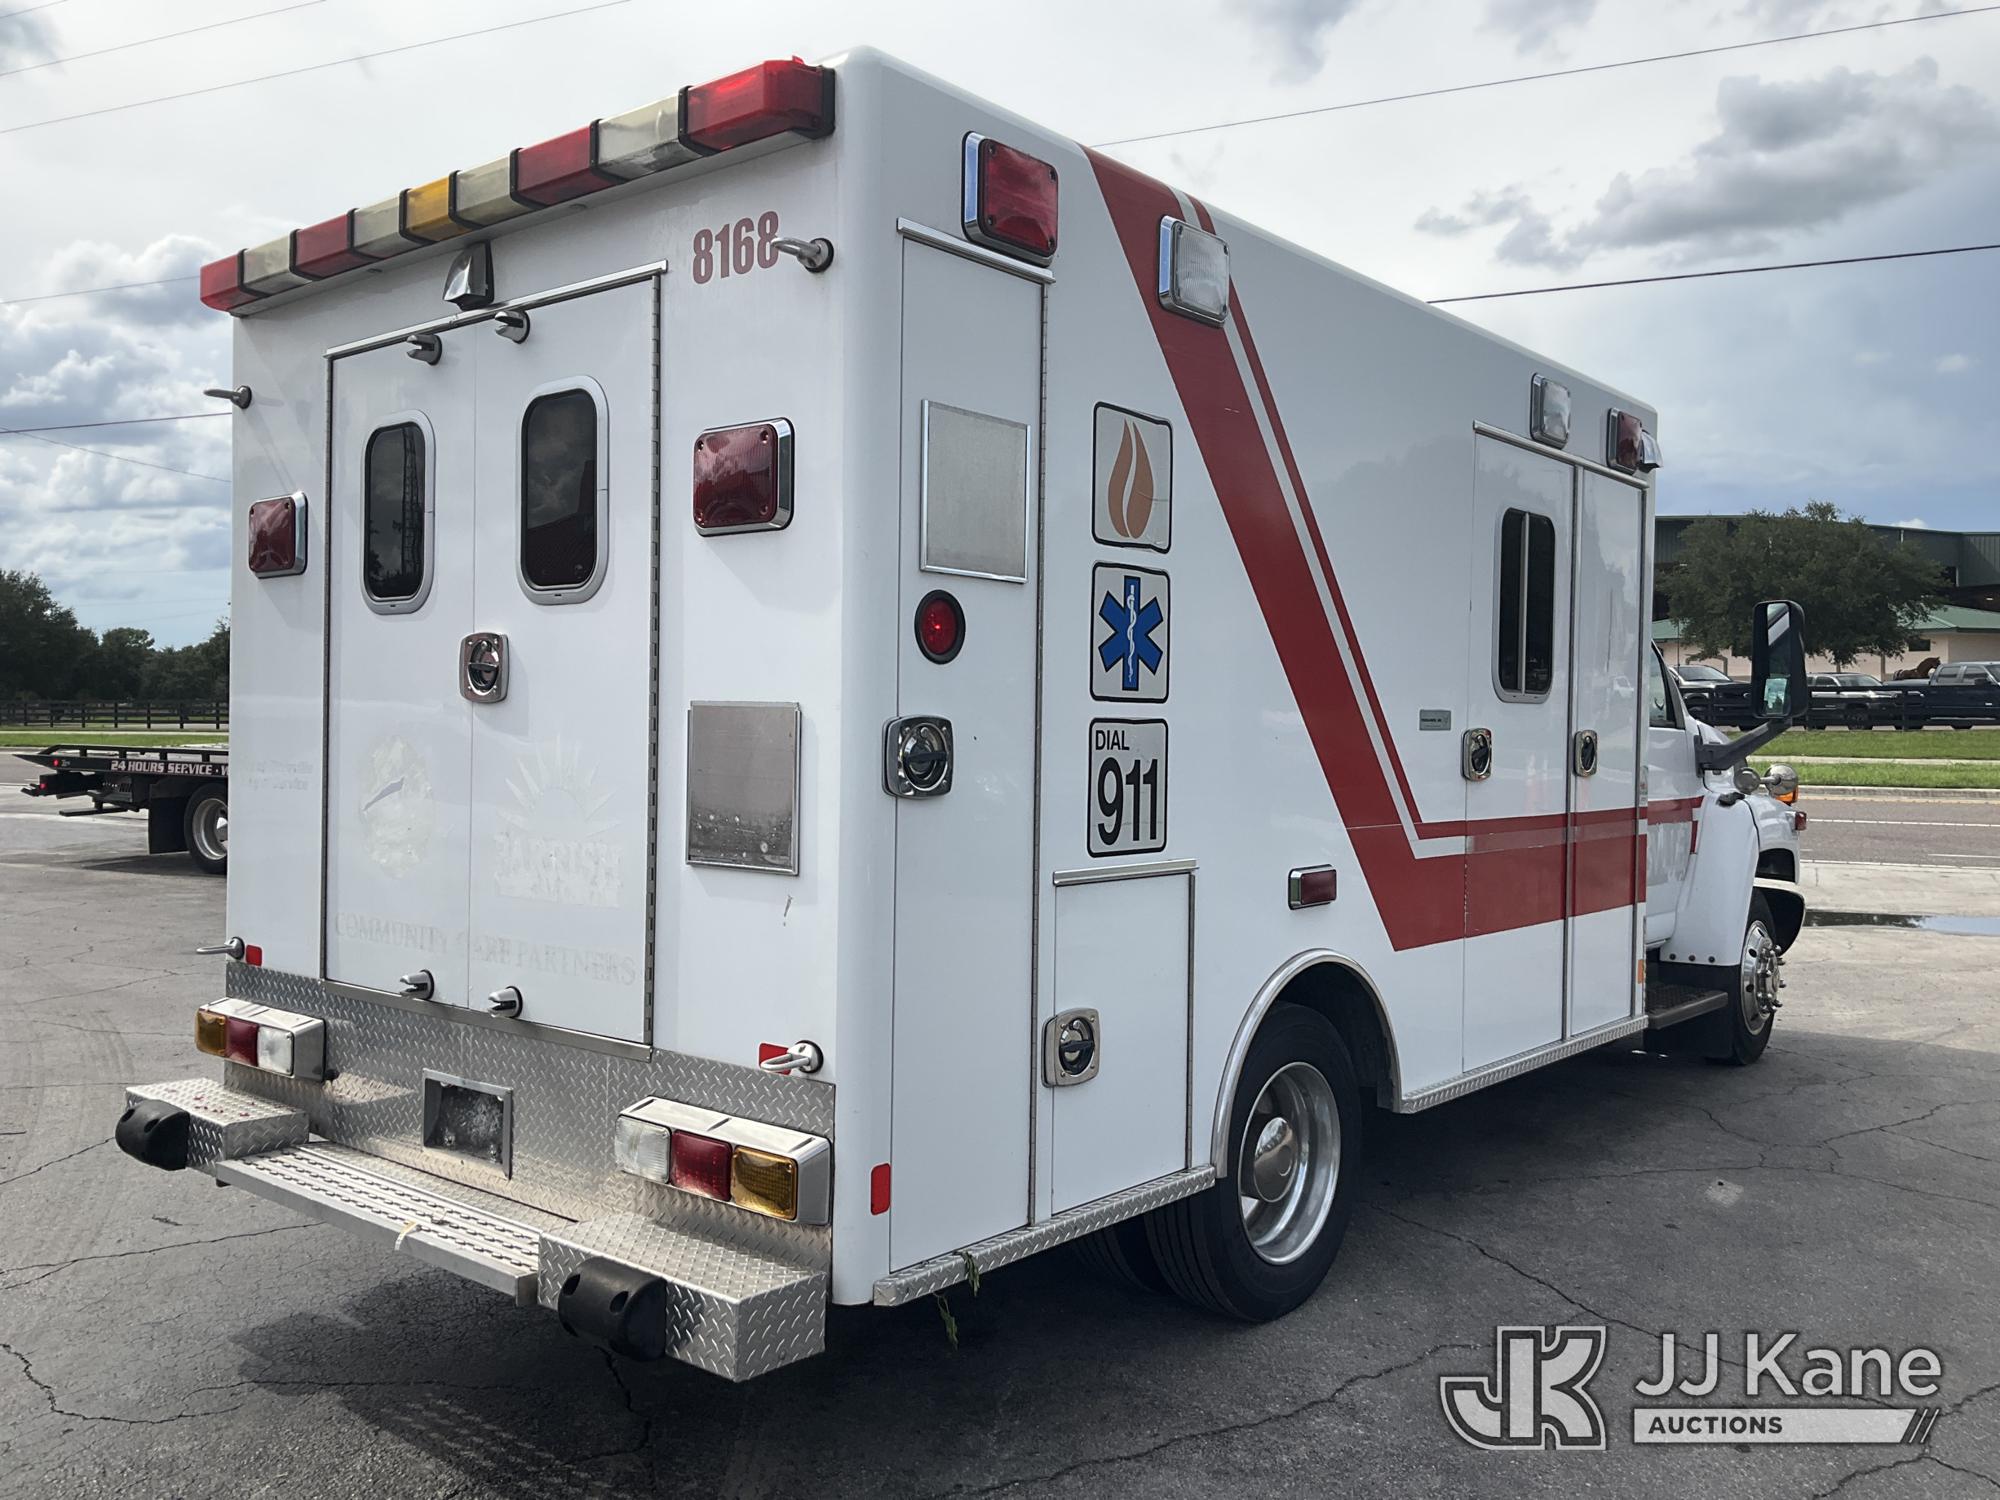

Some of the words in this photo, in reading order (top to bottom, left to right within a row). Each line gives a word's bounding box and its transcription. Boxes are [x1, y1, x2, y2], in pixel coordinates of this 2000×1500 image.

[693, 211, 779, 284] 8168
[1095, 730, 1130, 751] DIAL
[111, 760, 127, 771] 24
[128, 760, 165, 773] HOURS
[167, 762, 213, 775] SERVICE
[1097, 757, 1158, 845] 911
